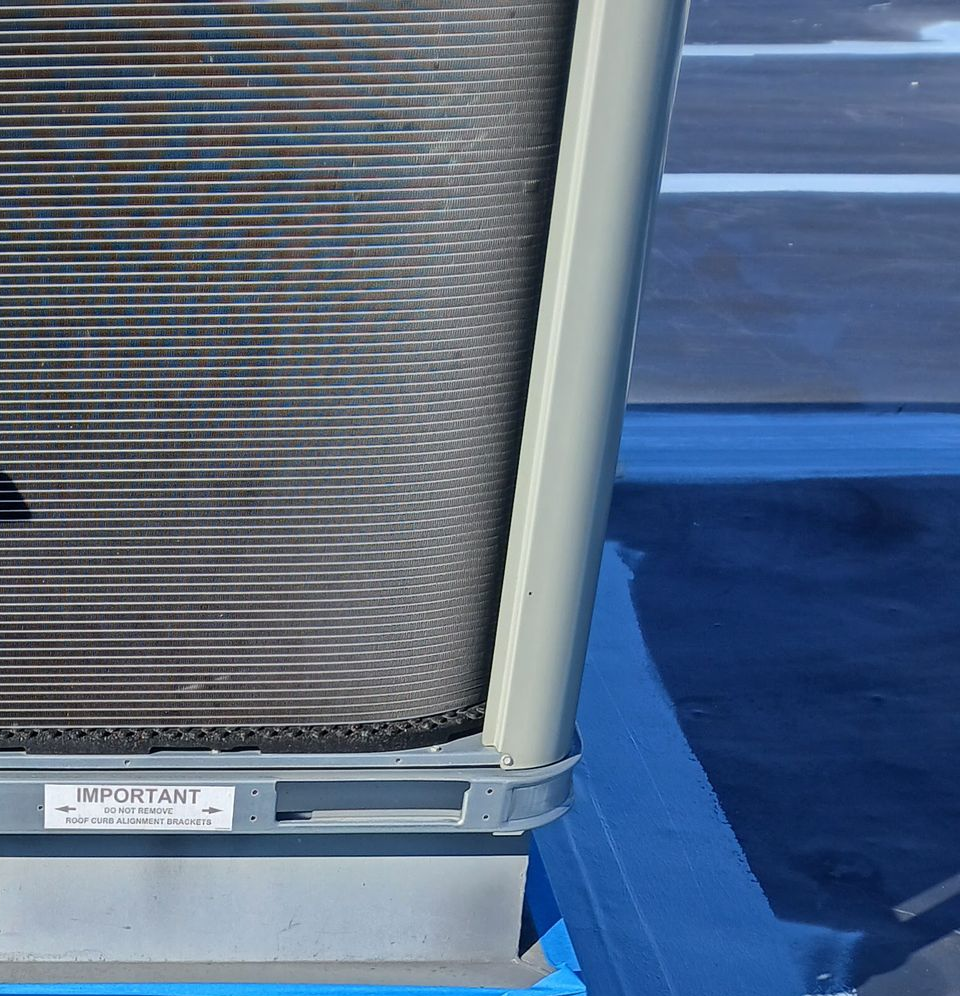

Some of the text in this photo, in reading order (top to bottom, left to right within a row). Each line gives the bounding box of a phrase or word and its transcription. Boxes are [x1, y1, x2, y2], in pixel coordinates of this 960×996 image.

[76, 788, 201, 804] IMPORTANT
[138, 807, 173, 815] REMOVE
[65, 817, 89, 825] ROOF
[91, 817, 114, 825] CURB
[167, 818, 212, 826] BRACKETS
